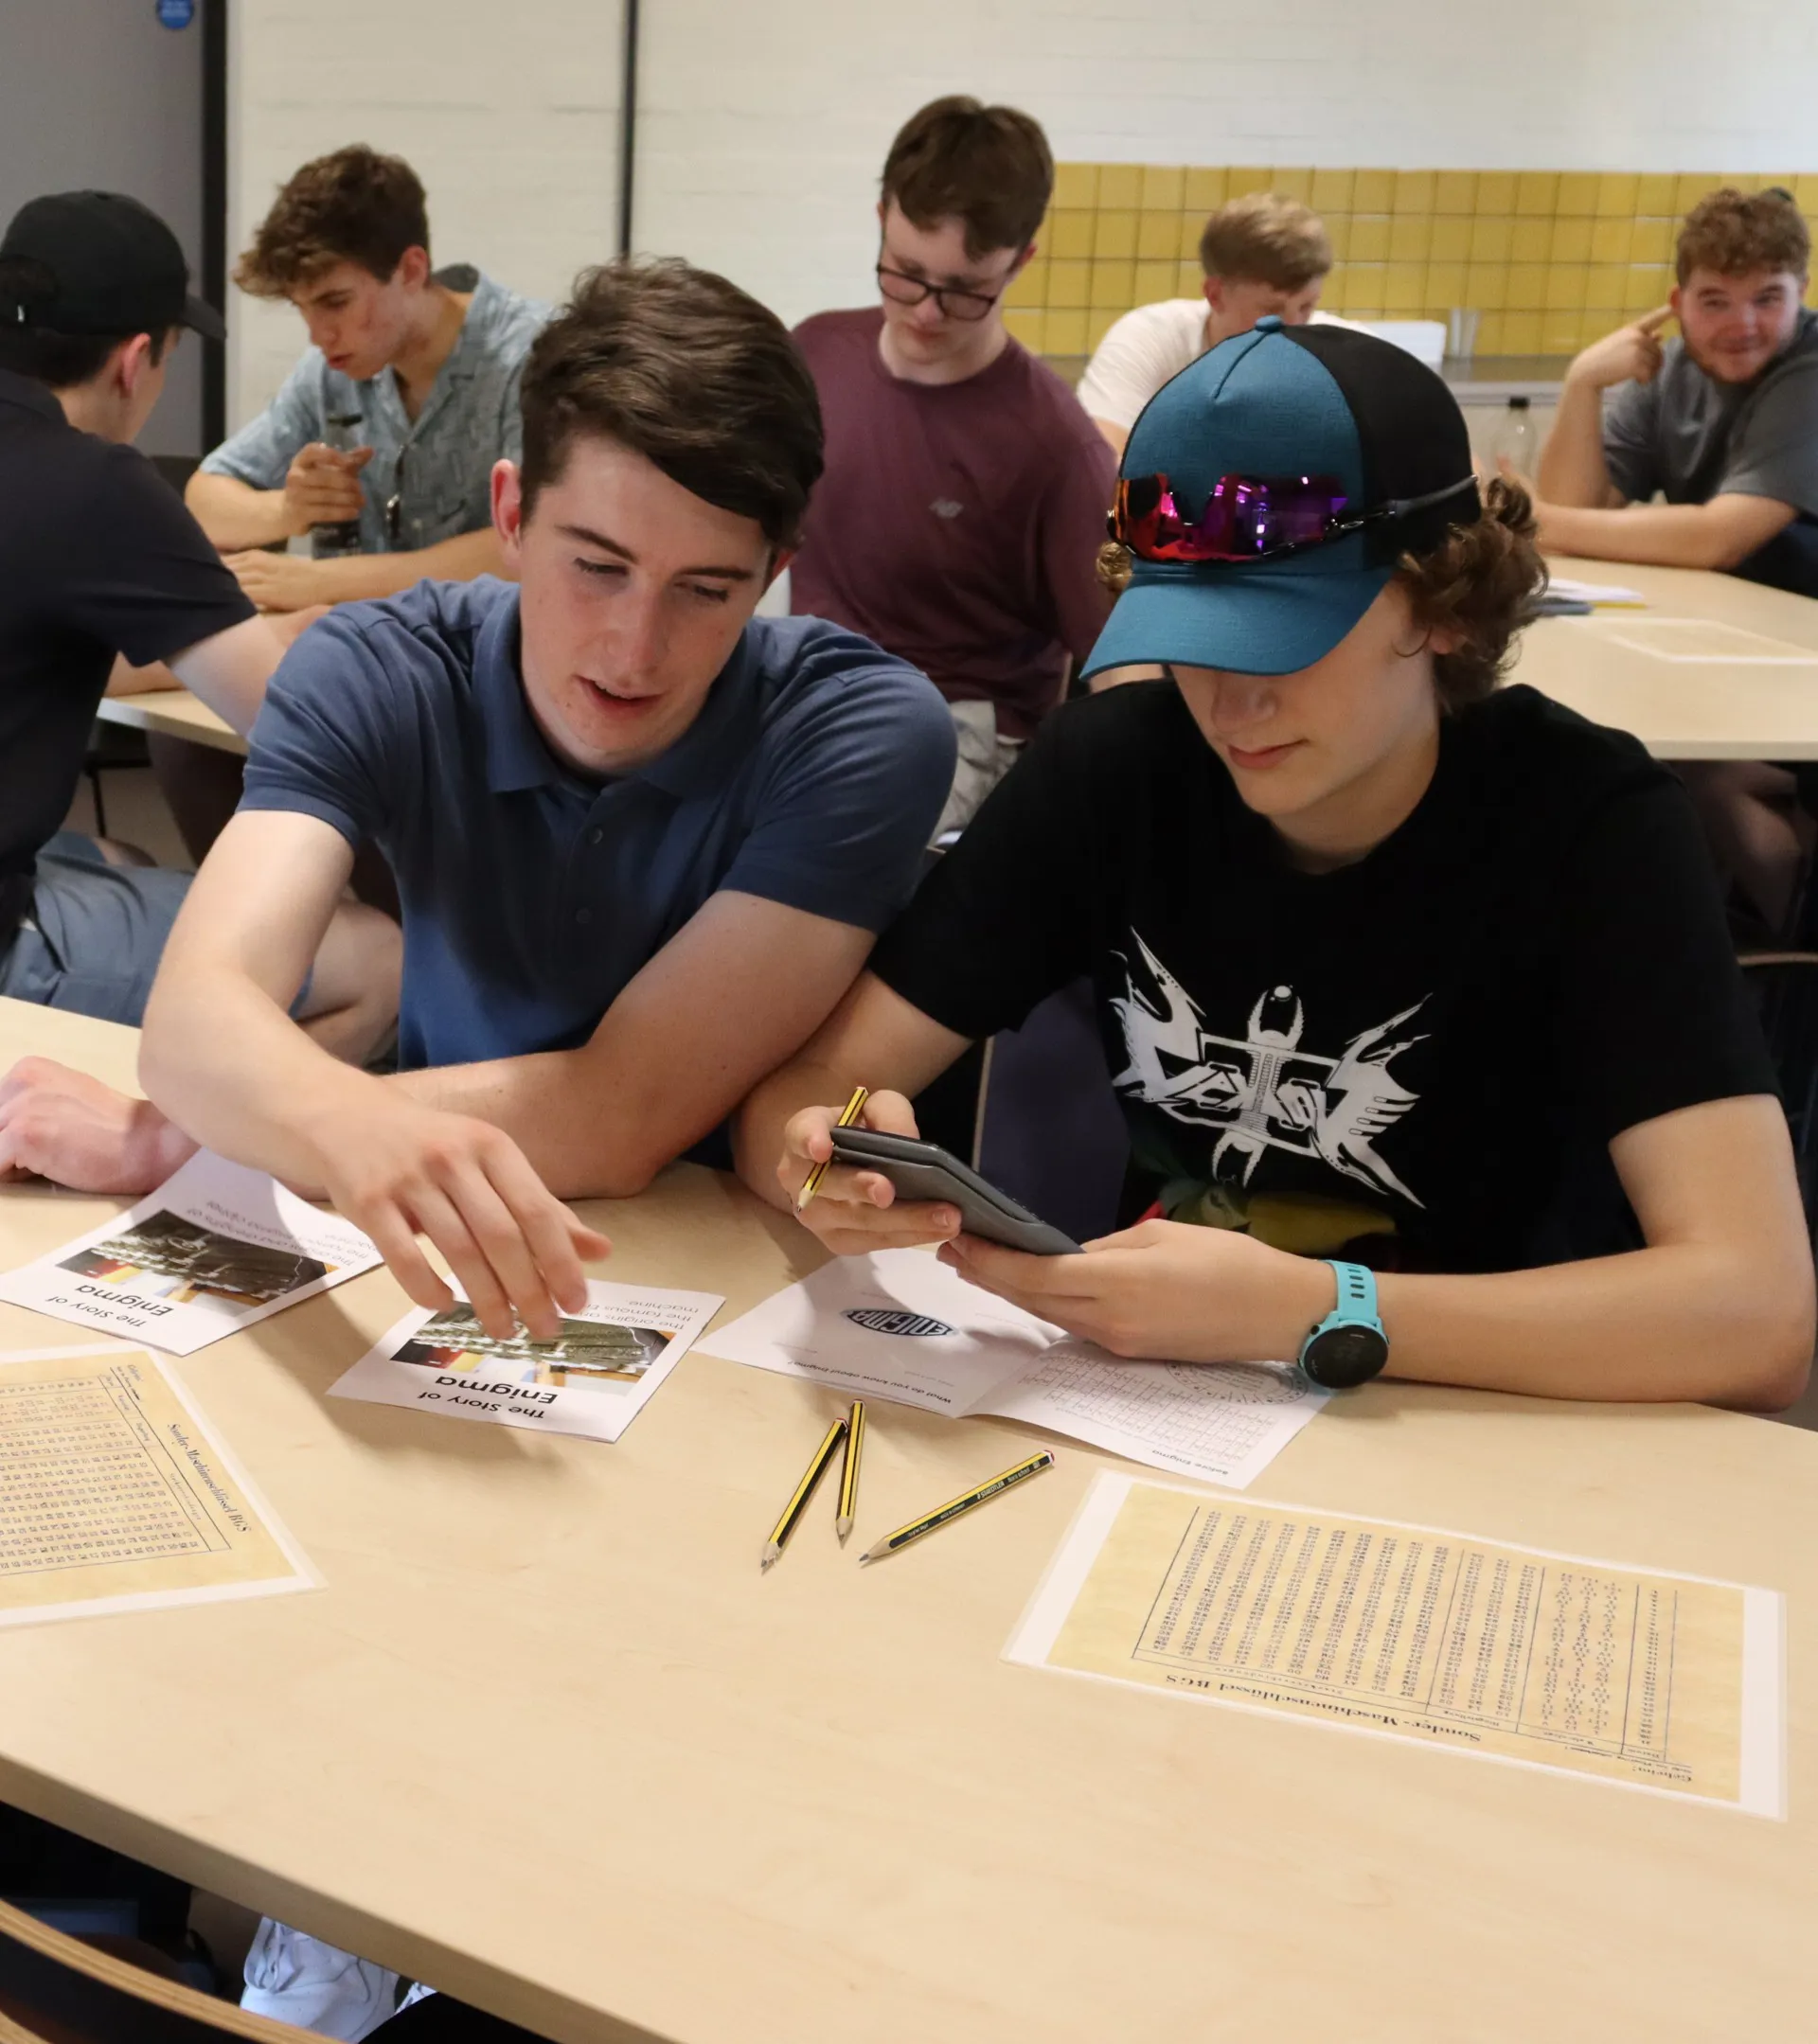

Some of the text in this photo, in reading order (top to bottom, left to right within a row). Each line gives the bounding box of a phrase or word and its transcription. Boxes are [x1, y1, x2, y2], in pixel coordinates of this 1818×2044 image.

[76, 1285, 173, 1316] Enigma
[71, 1303, 114, 1318] Story
[116, 1315, 146, 1327] The
[852, 1309, 948, 1334] ENIGMA
[863, 1376, 888, 1384] know
[436, 1377, 558, 1404] Enigma
[926, 1393, 951, 1404] What
[447, 1395, 501, 1412] Story
[508, 1407, 544, 1418] The
[1152, 1449, 1228, 1475] Before Enigma
[979, 1479, 1006, 1497] STAEDTLER
[1167, 1676, 1209, 1688] BGS
